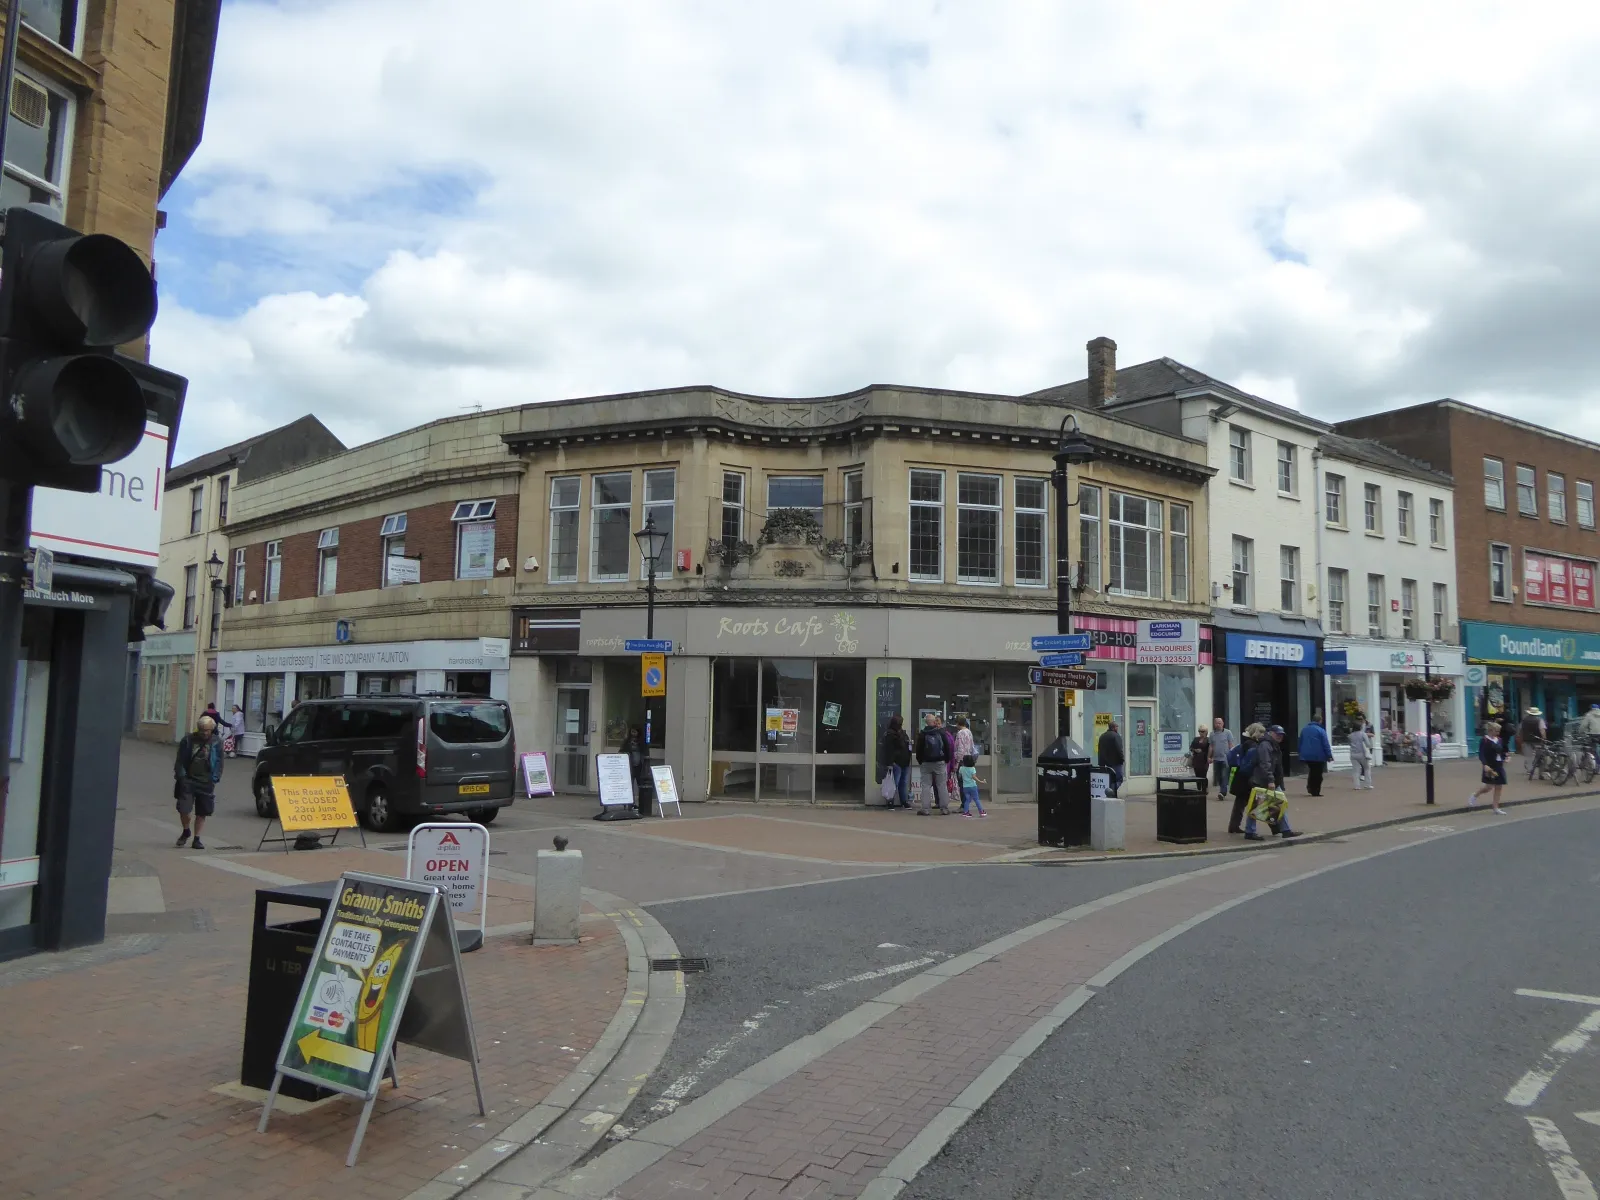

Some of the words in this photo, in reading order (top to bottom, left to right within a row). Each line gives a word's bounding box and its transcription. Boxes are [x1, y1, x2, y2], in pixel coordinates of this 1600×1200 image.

[102, 468, 144, 502] me
[71, 592, 94, 603] More
[717, 617, 769, 639] Roots
[774, 616, 824, 647] Cafe
[1244, 640, 1304, 662] BETFRED
[1500, 634, 1561, 657] Poundland
[319, 654, 331, 665] THE
[331, 653, 344, 665] WIG
[344, 652, 376, 665] COMPANY
[376, 651, 409, 663] TAUNTON
[1067, 672, 1086, 680] Theatre
[302, 788, 324, 796] Road
[302, 796, 338, 804] CLOSED
[288, 814, 313, 822] 14.00
[321, 813, 348, 821] 23.00
[426, 859, 469, 872] OPEN
[341, 888, 385, 916] Granny
[383, 895, 426, 920] Smiths
[336, 909, 365, 922] Traditional
[364, 915, 384, 927] Quality
[384, 919, 420, 933] Greengrocers
[341, 928, 353, 938] WE
[354, 931, 371, 942] TAKE
[330, 937, 377, 954] CONTACTLESS
[332, 948, 368, 963] PAYMENTS
